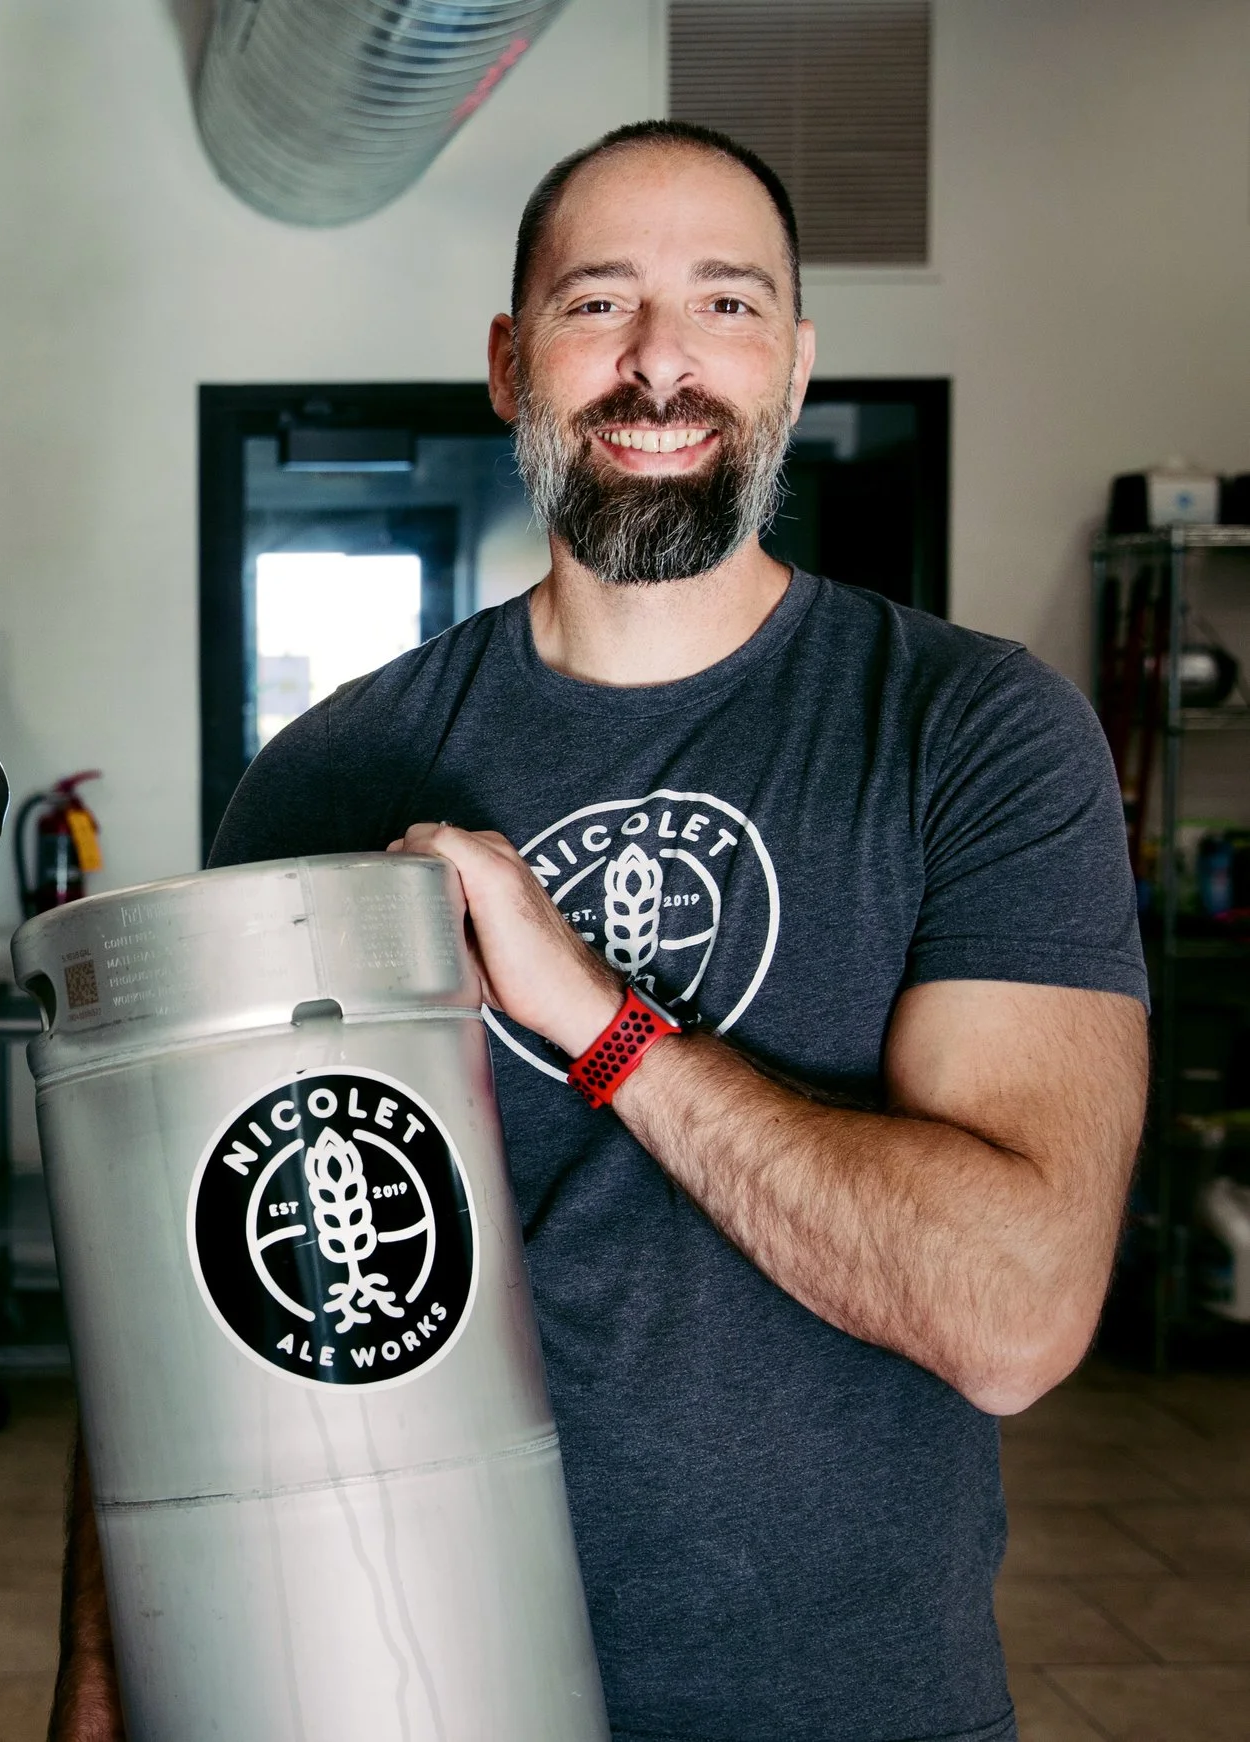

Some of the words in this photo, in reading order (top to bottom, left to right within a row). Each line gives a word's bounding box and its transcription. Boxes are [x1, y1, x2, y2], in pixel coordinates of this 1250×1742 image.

[530, 811, 738, 888] NICOLET
[663, 893, 700, 908] 2019
[222, 1088, 426, 1176] NICOLET
[268, 1201, 299, 1217] EST
[372, 1182, 408, 1199] 2019
[276, 1333, 335, 1367] ALE
[350, 1302, 447, 1368] WORKS
